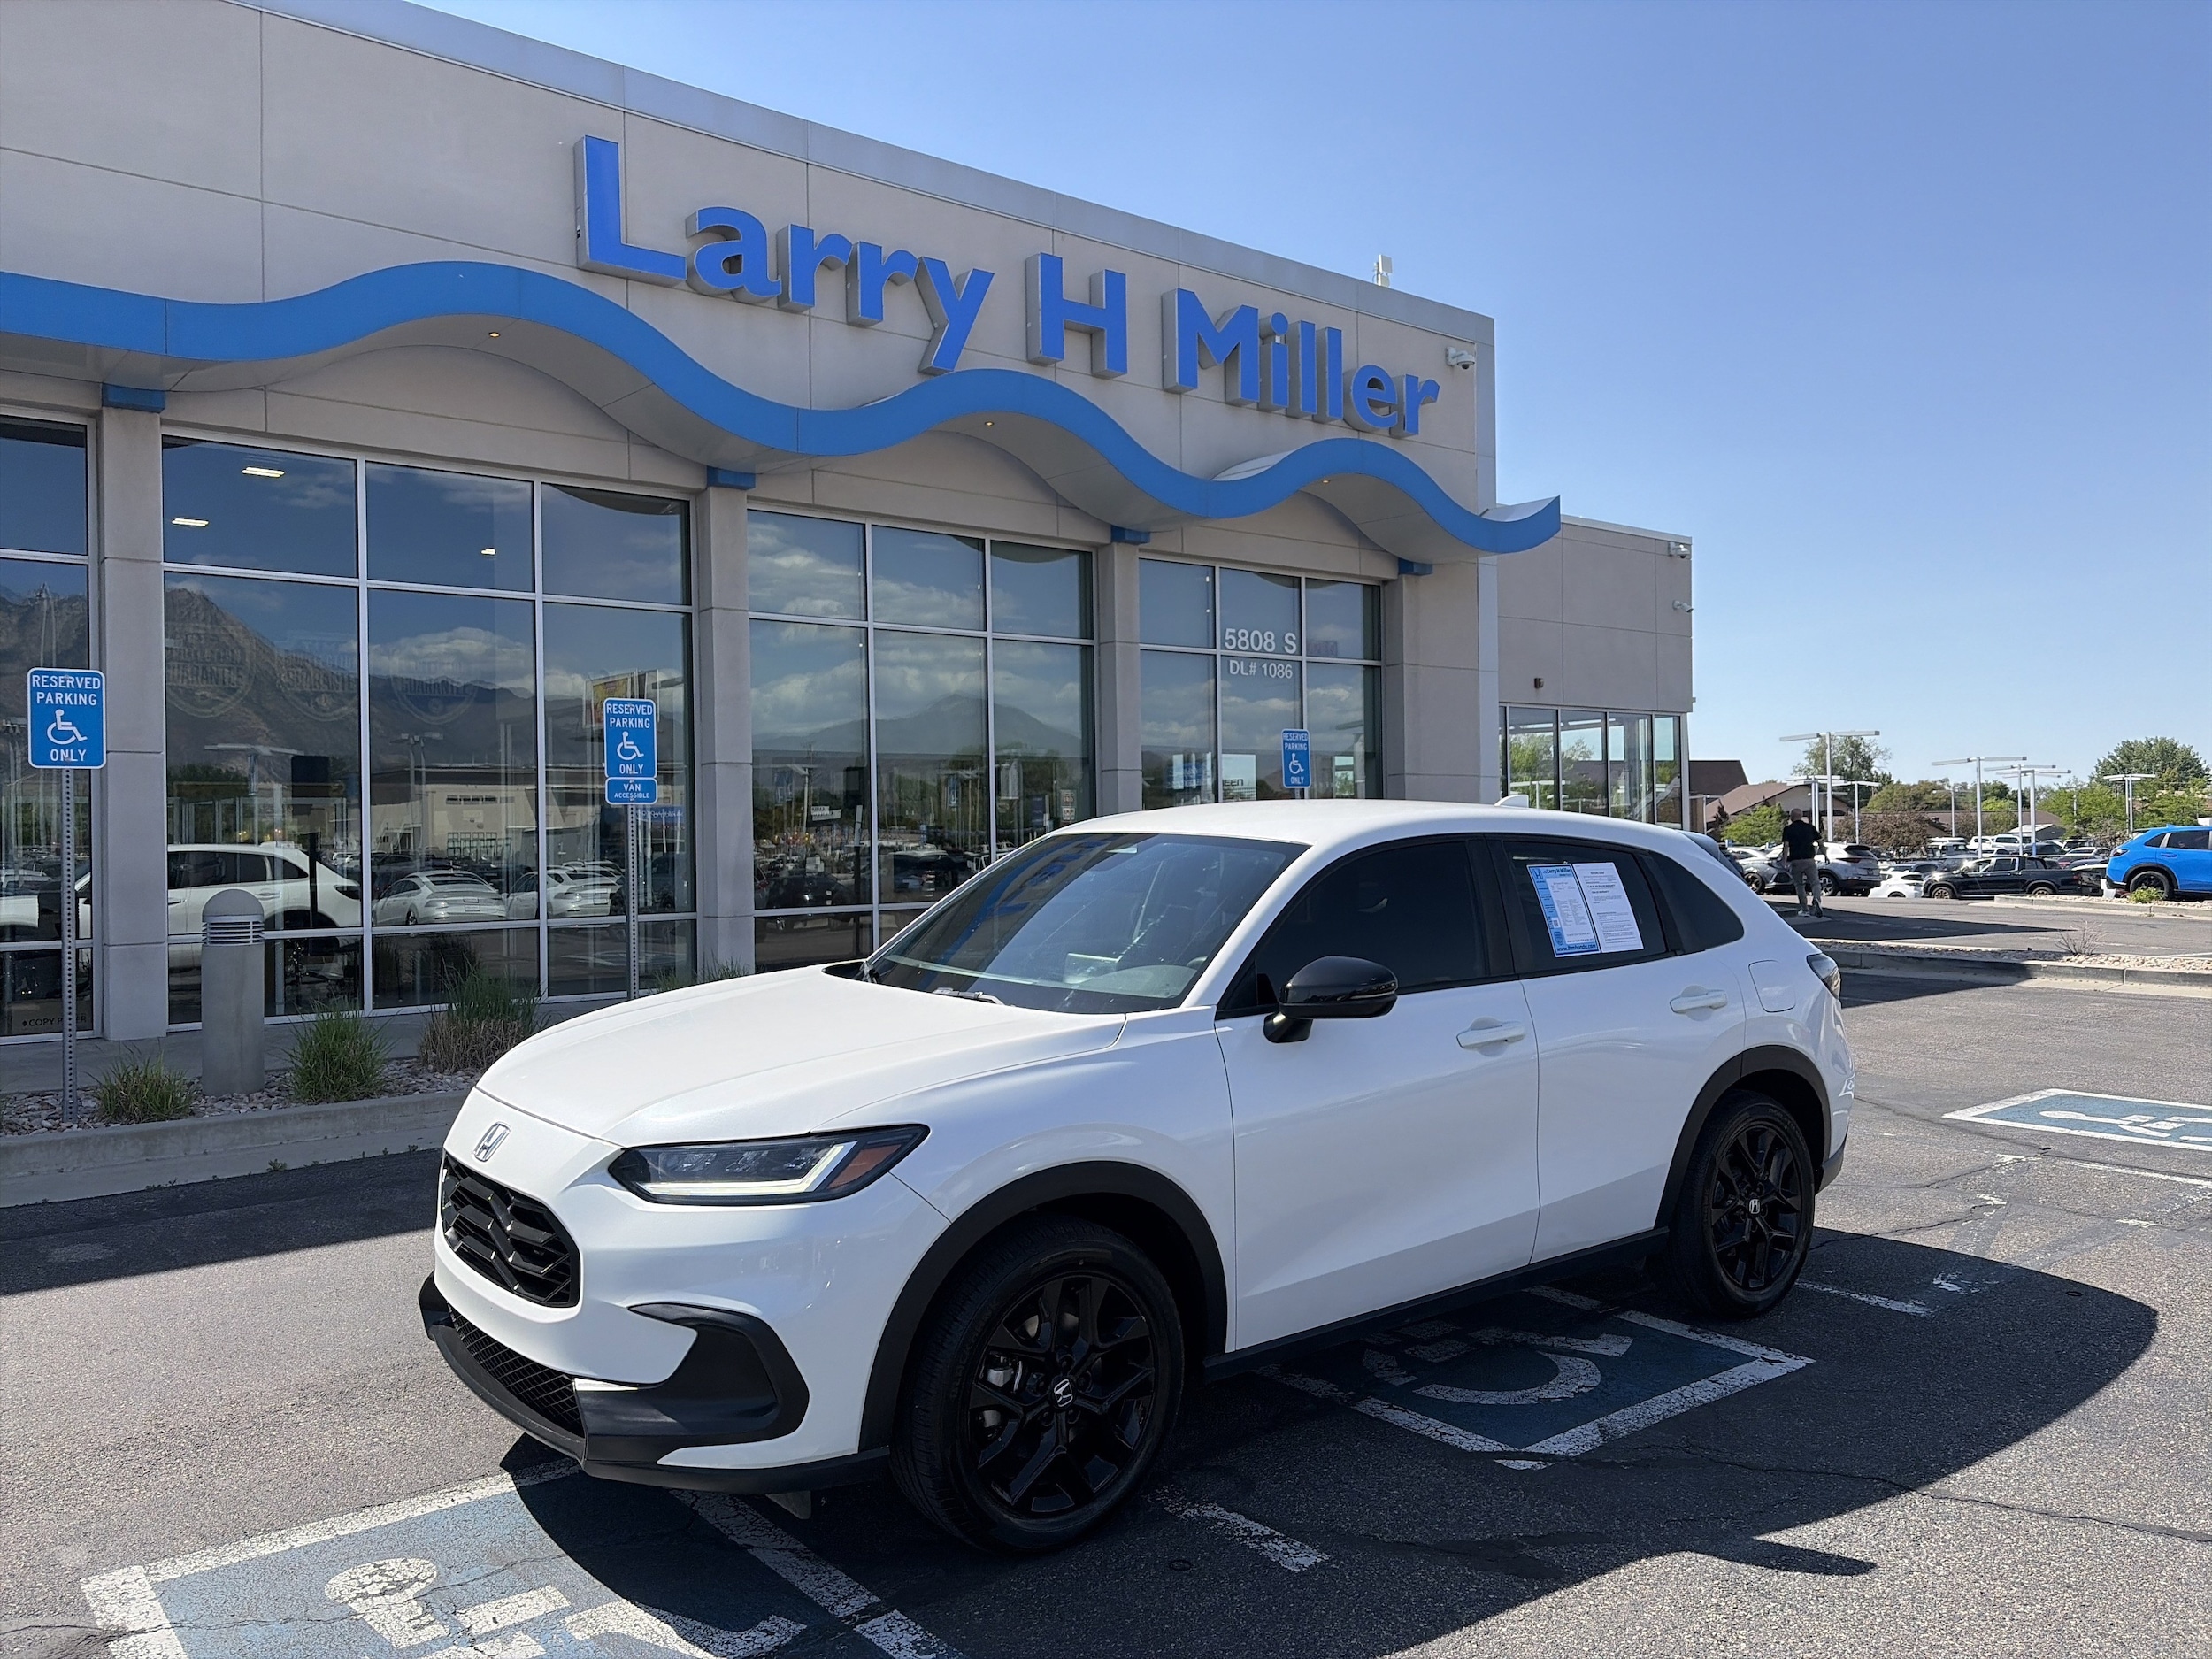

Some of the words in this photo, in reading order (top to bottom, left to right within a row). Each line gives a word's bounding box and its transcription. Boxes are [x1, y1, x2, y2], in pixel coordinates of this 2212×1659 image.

[575, 135, 994, 375] Larry
[1026, 252, 1127, 379] H
[1163, 288, 1440, 438] Miller
[1225, 628, 1276, 653] 5808
[1284, 632, 1297, 654] S
[1229, 660, 1256, 676] DL#
[1262, 663, 1293, 679] 1086
[32, 675, 101, 689] RESERVED
[36, 692, 97, 706] PARKING
[606, 703, 653, 715] RESERVED
[610, 718, 650, 728] PARKING
[50, 749, 87, 762] ONLY
[619, 764, 644, 774] ONLY
[1290, 776, 1304, 785] ONLY
[623, 783, 641, 792] VAN
[28, 1018, 55, 1026] COPY
[57, 1015, 87, 1025] PER
